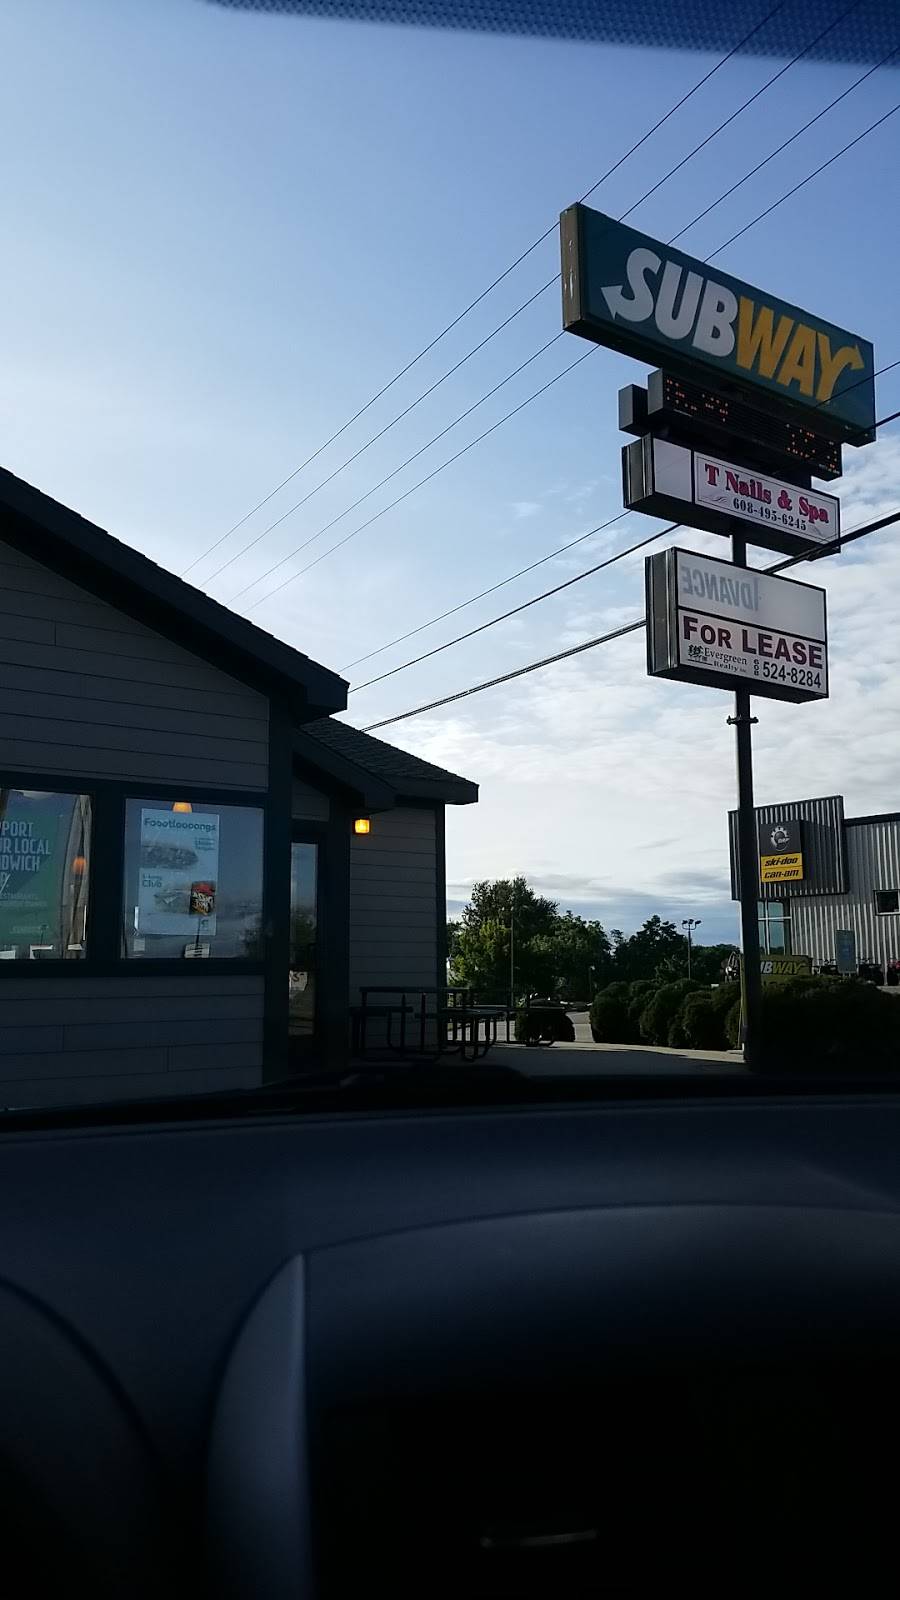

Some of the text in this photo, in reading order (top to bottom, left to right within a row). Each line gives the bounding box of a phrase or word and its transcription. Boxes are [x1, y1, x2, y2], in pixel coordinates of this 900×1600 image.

[601, 248, 864, 403] SUBWAY
[705, 463, 829, 524] T Nails & Spa
[733, 498, 807, 531] 608-495-6245
[683, 616, 823, 669] FOR LEASE
[704, 647, 747, 665] Evergreen
[714, 661, 739, 672] Realty
[763, 661, 821, 688] 524-8284
[0, 821, 34, 837] PORT
[15, 839, 52, 855] LOCAL
[0, 854, 40, 872] DWICH
[765, 857, 798, 867] ski-doo
[764, 870, 799, 879] can-am
[760, 961, 804, 974] BWAY
